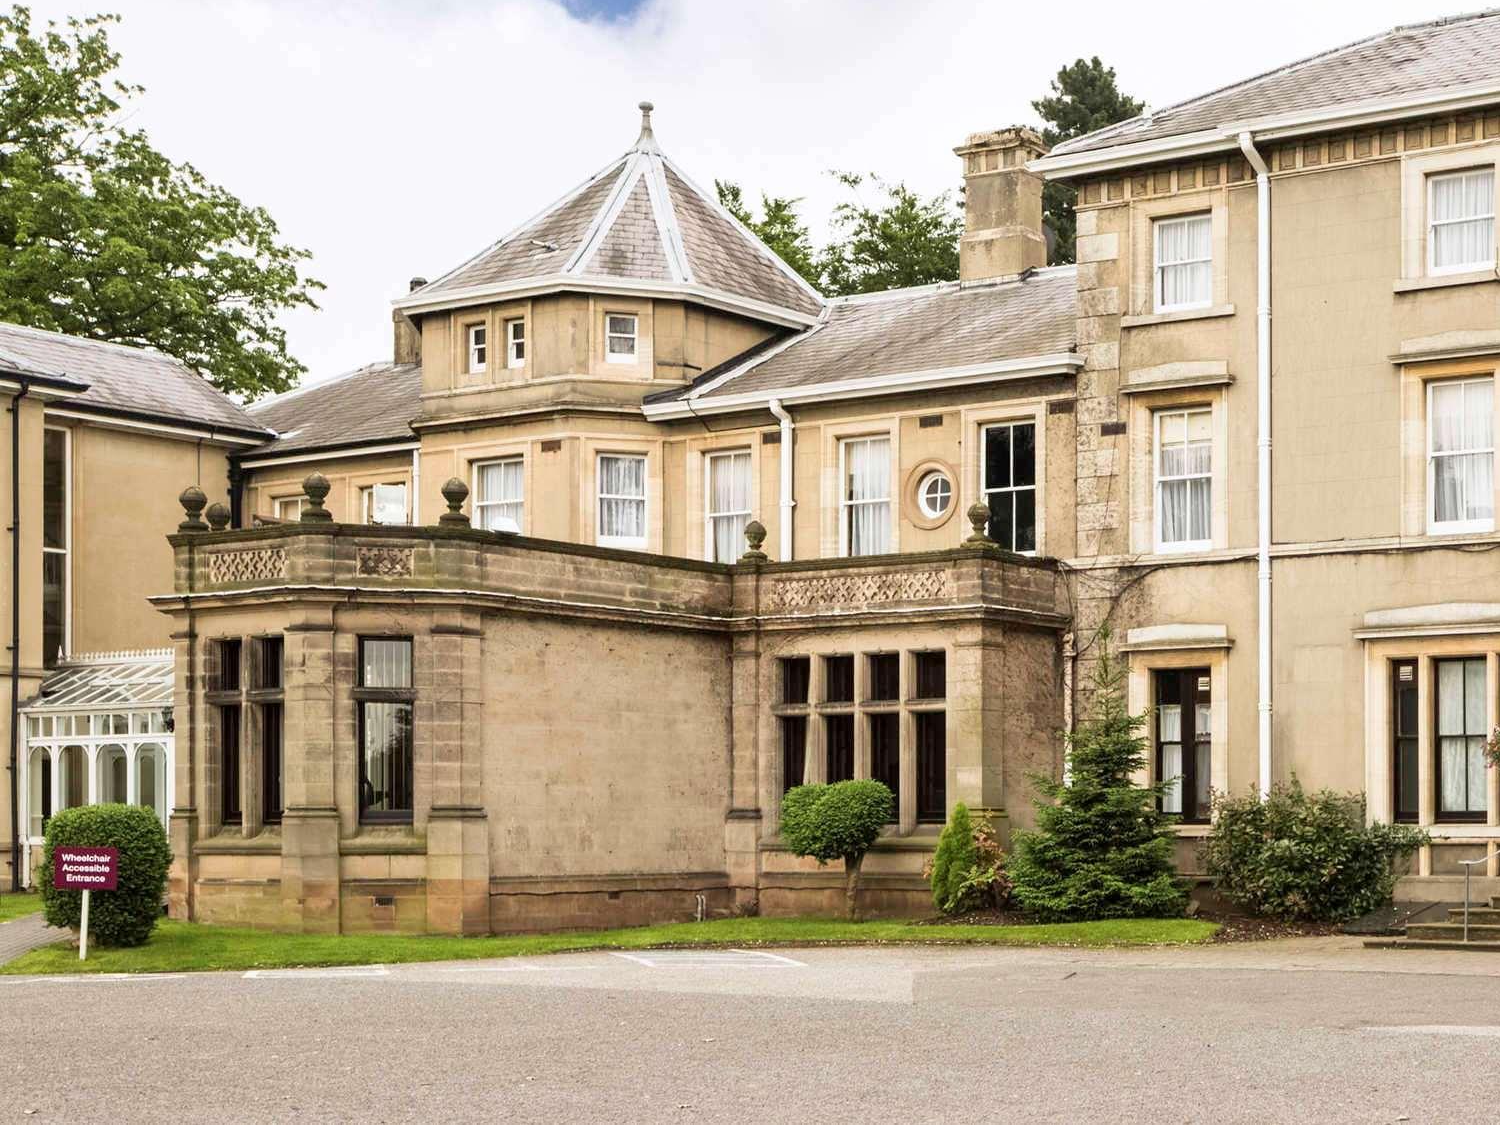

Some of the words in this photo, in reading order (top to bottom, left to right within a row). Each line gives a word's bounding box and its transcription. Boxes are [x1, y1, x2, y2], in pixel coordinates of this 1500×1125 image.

[61, 853, 111, 863] Wheelchair
[62, 863, 110, 873] Accessible
[66, 873, 106, 883] Entrance
